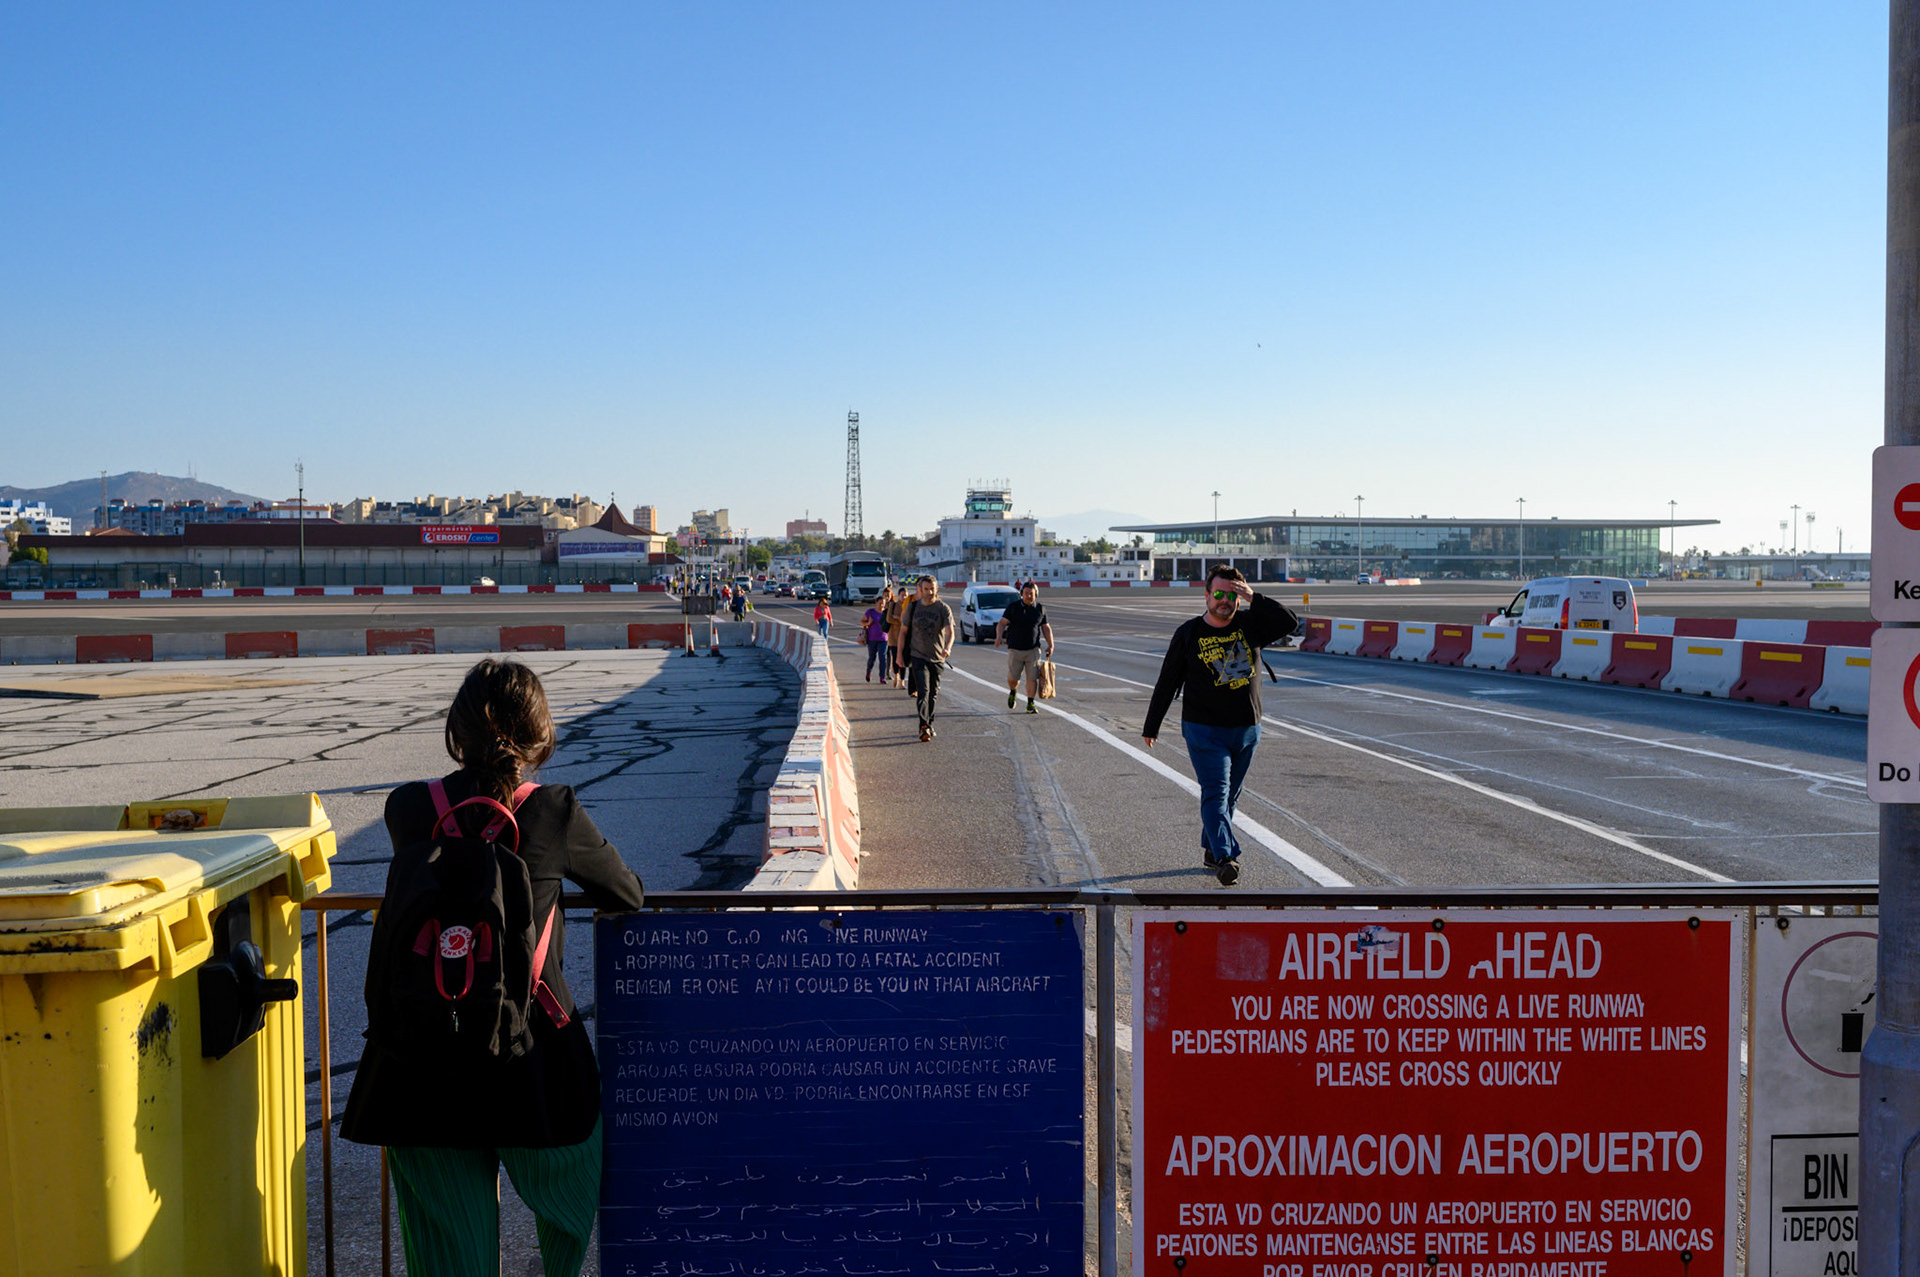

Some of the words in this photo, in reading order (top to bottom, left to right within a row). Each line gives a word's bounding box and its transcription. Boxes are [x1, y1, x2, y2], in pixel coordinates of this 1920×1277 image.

[1894, 580, 1920, 600] Ke
[1615, 596, 1624, 608] 5
[1879, 763, 1911, 782] Do
[623, 929, 647, 946] OU
[650, 929, 681, 945] ARE
[686, 929, 709, 945] NO
[727, 928, 809, 945] COING
[827, 928, 860, 944] IVE
[863, 928, 928, 943] RUNWAY
[755, 953, 788, 969] CAN
[792, 953, 832, 969] LEAD
[836, 953, 856, 968] TO
[861, 953, 871, 968] A
[875, 952, 921, 968] FATAL
[924, 952, 1004, 968] ACCIDENT.
[1279, 932, 1451, 980] AIRFIELD
[615, 978, 702, 995] REMEMER
[706, 978, 740, 995] ONE
[755, 978, 773, 994] AY
[778, 977, 790, 994] IT
[795, 977, 850, 994] COULD
[853, 977, 873, 993] BE
[877, 977, 910, 993] YOU
[914, 977, 930, 992] IN
[933, 976, 972, 992] THAT
[975, 976, 1051, 992] AIRCRAFT
[1231, 995, 1272, 1021] YOU
[1280, 995, 1319, 1020] ARE
[1328, 995, 1374, 1020] NOW
[1383, 994, 1487, 1020] CROSSING
[1495, 995, 1510, 1019] A
[1518, 994, 1560, 1019] LIVE
[1568, 993, 1645, 1018] RUNWAY
[688, 1038, 774, 1055] CRUZANDO
[779, 1038, 801, 1053] UN
[805, 1037, 910, 1053] AEROPUERTO
[914, 1036, 934, 1052] EN
[939, 1035, 1009, 1052] SERVICIO
[1172, 1029, 1307, 1055] PEDESTRIANS
[1315, 1028, 1355, 1053] ARE
[1364, 1028, 1389, 1053] TO
[1398, 1028, 1450, 1053] KEEP
[1458, 1027, 1526, 1052] WITHIN
[1533, 1027, 1572, 1052] THE
[1580, 1027, 1642, 1052] WHITE
[1650, 1026, 1707, 1051] LINES
[616, 1063, 688, 1079] ARROJAR
[693, 1062, 755, 1078] BASURA
[822, 1061, 884, 1076] CAUSAR
[888, 1060, 910, 1076] UN
[914, 1059, 1002, 1075] ACCIDENTE
[1007, 1058, 1057, 1074] GRAVE
[1316, 1061, 1391, 1087] PLEASE
[1400, 1061, 1470, 1087] CROSS
[1478, 1061, 1562, 1087] QUICKLY
[708, 1086, 730, 1102] UN
[734, 1086, 759, 1101] DIA
[858, 1084, 972, 1100] ENCONTRARSE
[977, 1084, 998, 1099] EN
[615, 1111, 667, 1128] MISMO
[672, 1110, 719, 1127] AVION
[1166, 1134, 1442, 1177] APROXIMACION
[1458, 1130, 1703, 1175] AEROPUERTO
[1803, 1154, 1848, 1199] BIN
[1179, 1203, 1228, 1226] ESTA
[1235, 1203, 1262, 1226] VD
[1271, 1202, 1382, 1226] CRUZANDO
[1390, 1202, 1417, 1225] UN
[1425, 1200, 1557, 1225] AEROPUERTO
[1565, 1200, 1591, 1223] EN
[1600, 1197, 1692, 1223] SERVICIO
[1156, 1233, 1258, 1257] PEATONES
[1266, 1232, 1416, 1256] MANTENGANSE
[1425, 1232, 1489, 1255] ENTRE
[1497, 1232, 1536, 1255] LAS
[1544, 1230, 1613, 1254] LINEAS
[1621, 1229, 1714, 1252] BLANCAS
[1263, 1263, 1304, 1277] POR
[1312, 1263, 1373, 1277] FAVOR
[1471, 1261, 1608, 1277] RAPIDAMENTE
